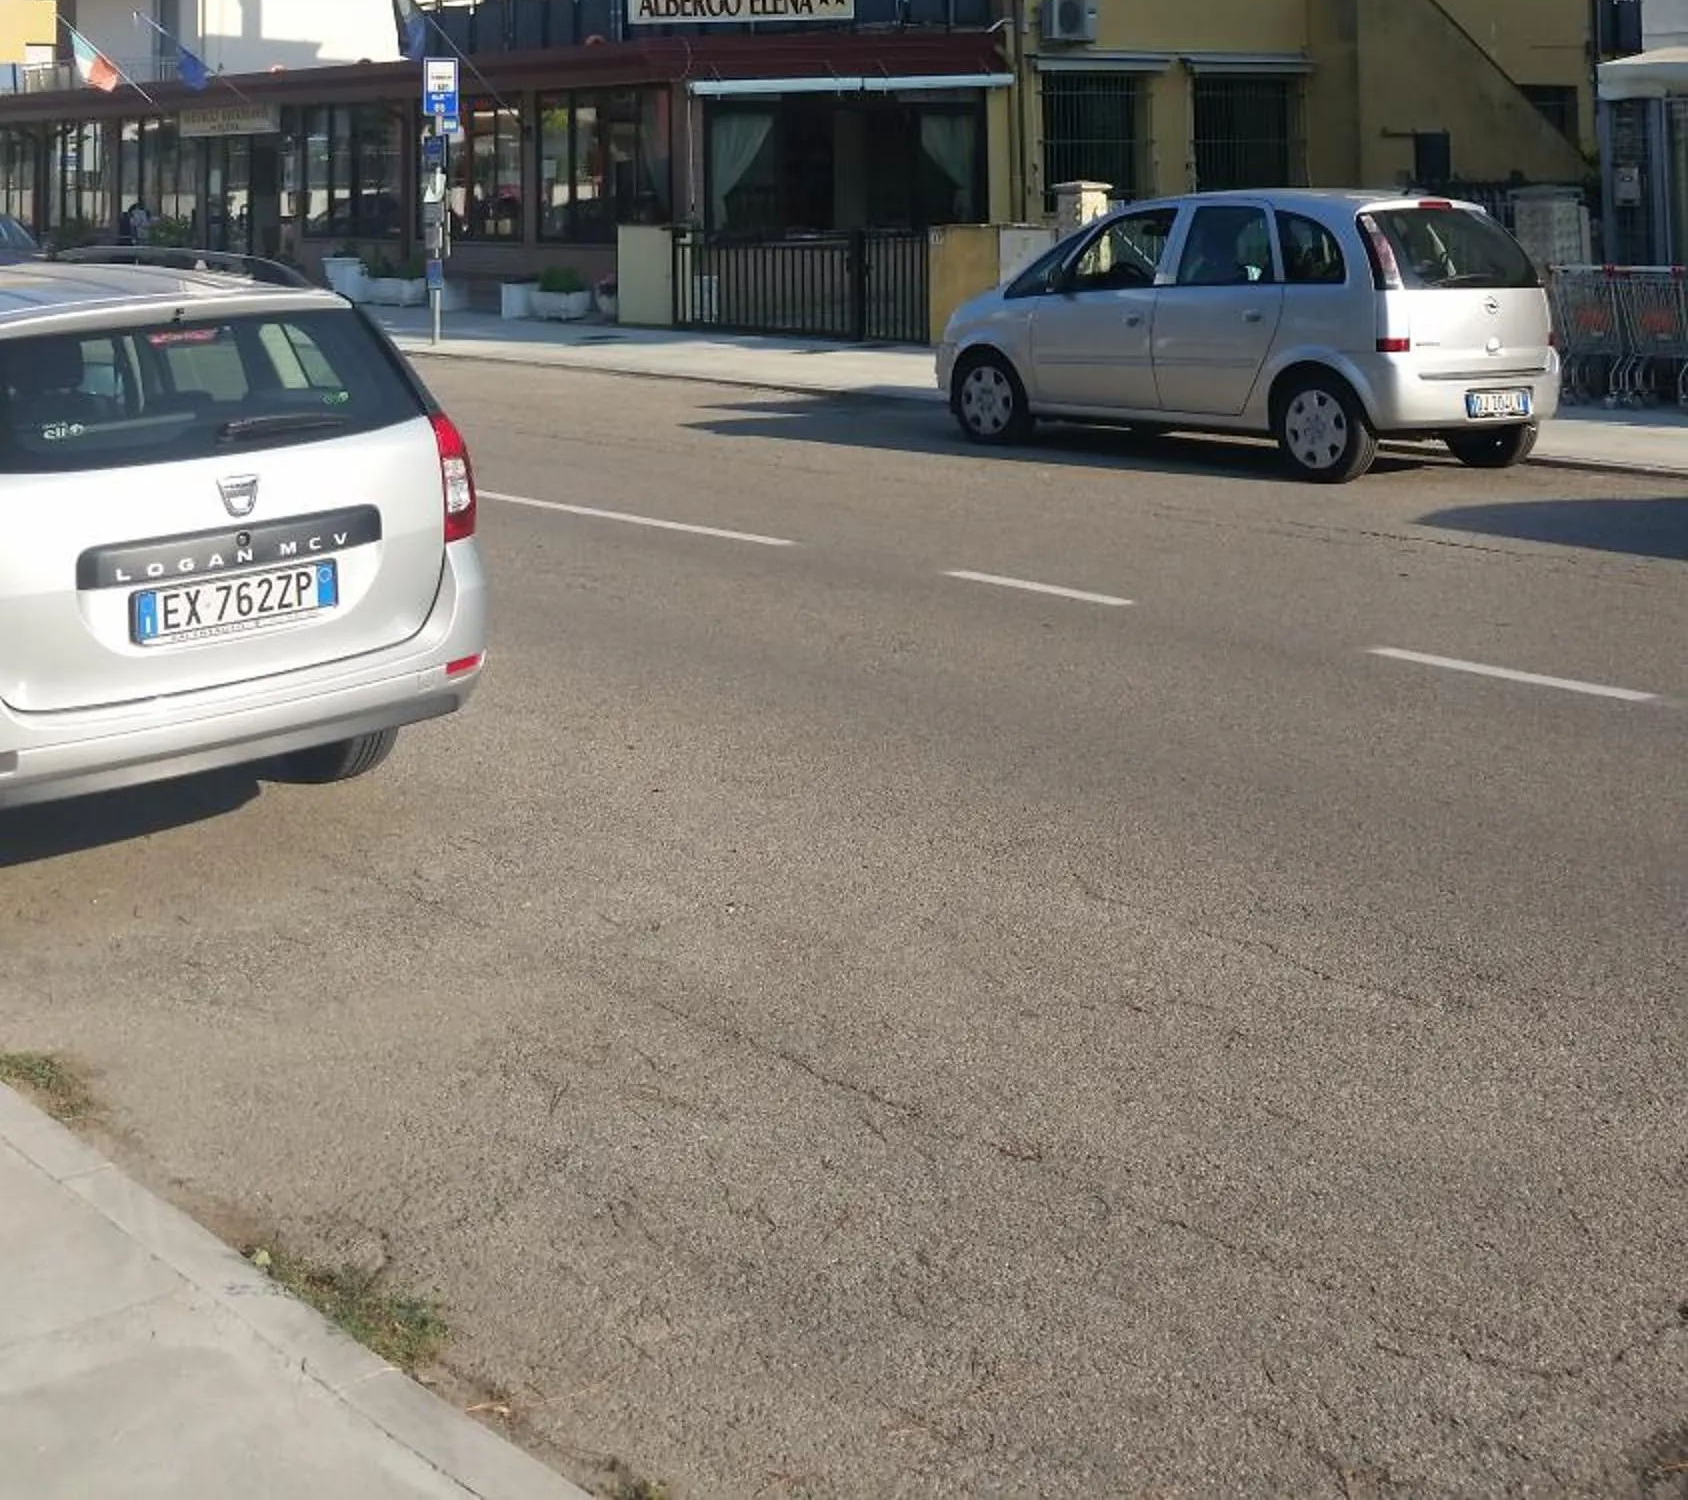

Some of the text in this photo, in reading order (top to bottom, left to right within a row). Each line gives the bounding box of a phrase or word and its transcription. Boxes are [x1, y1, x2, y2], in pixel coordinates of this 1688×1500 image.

[115, 533, 348, 581] LOGAN MCV
[163, 589, 202, 630] EX
[216, 571, 312, 621] 762ZP
